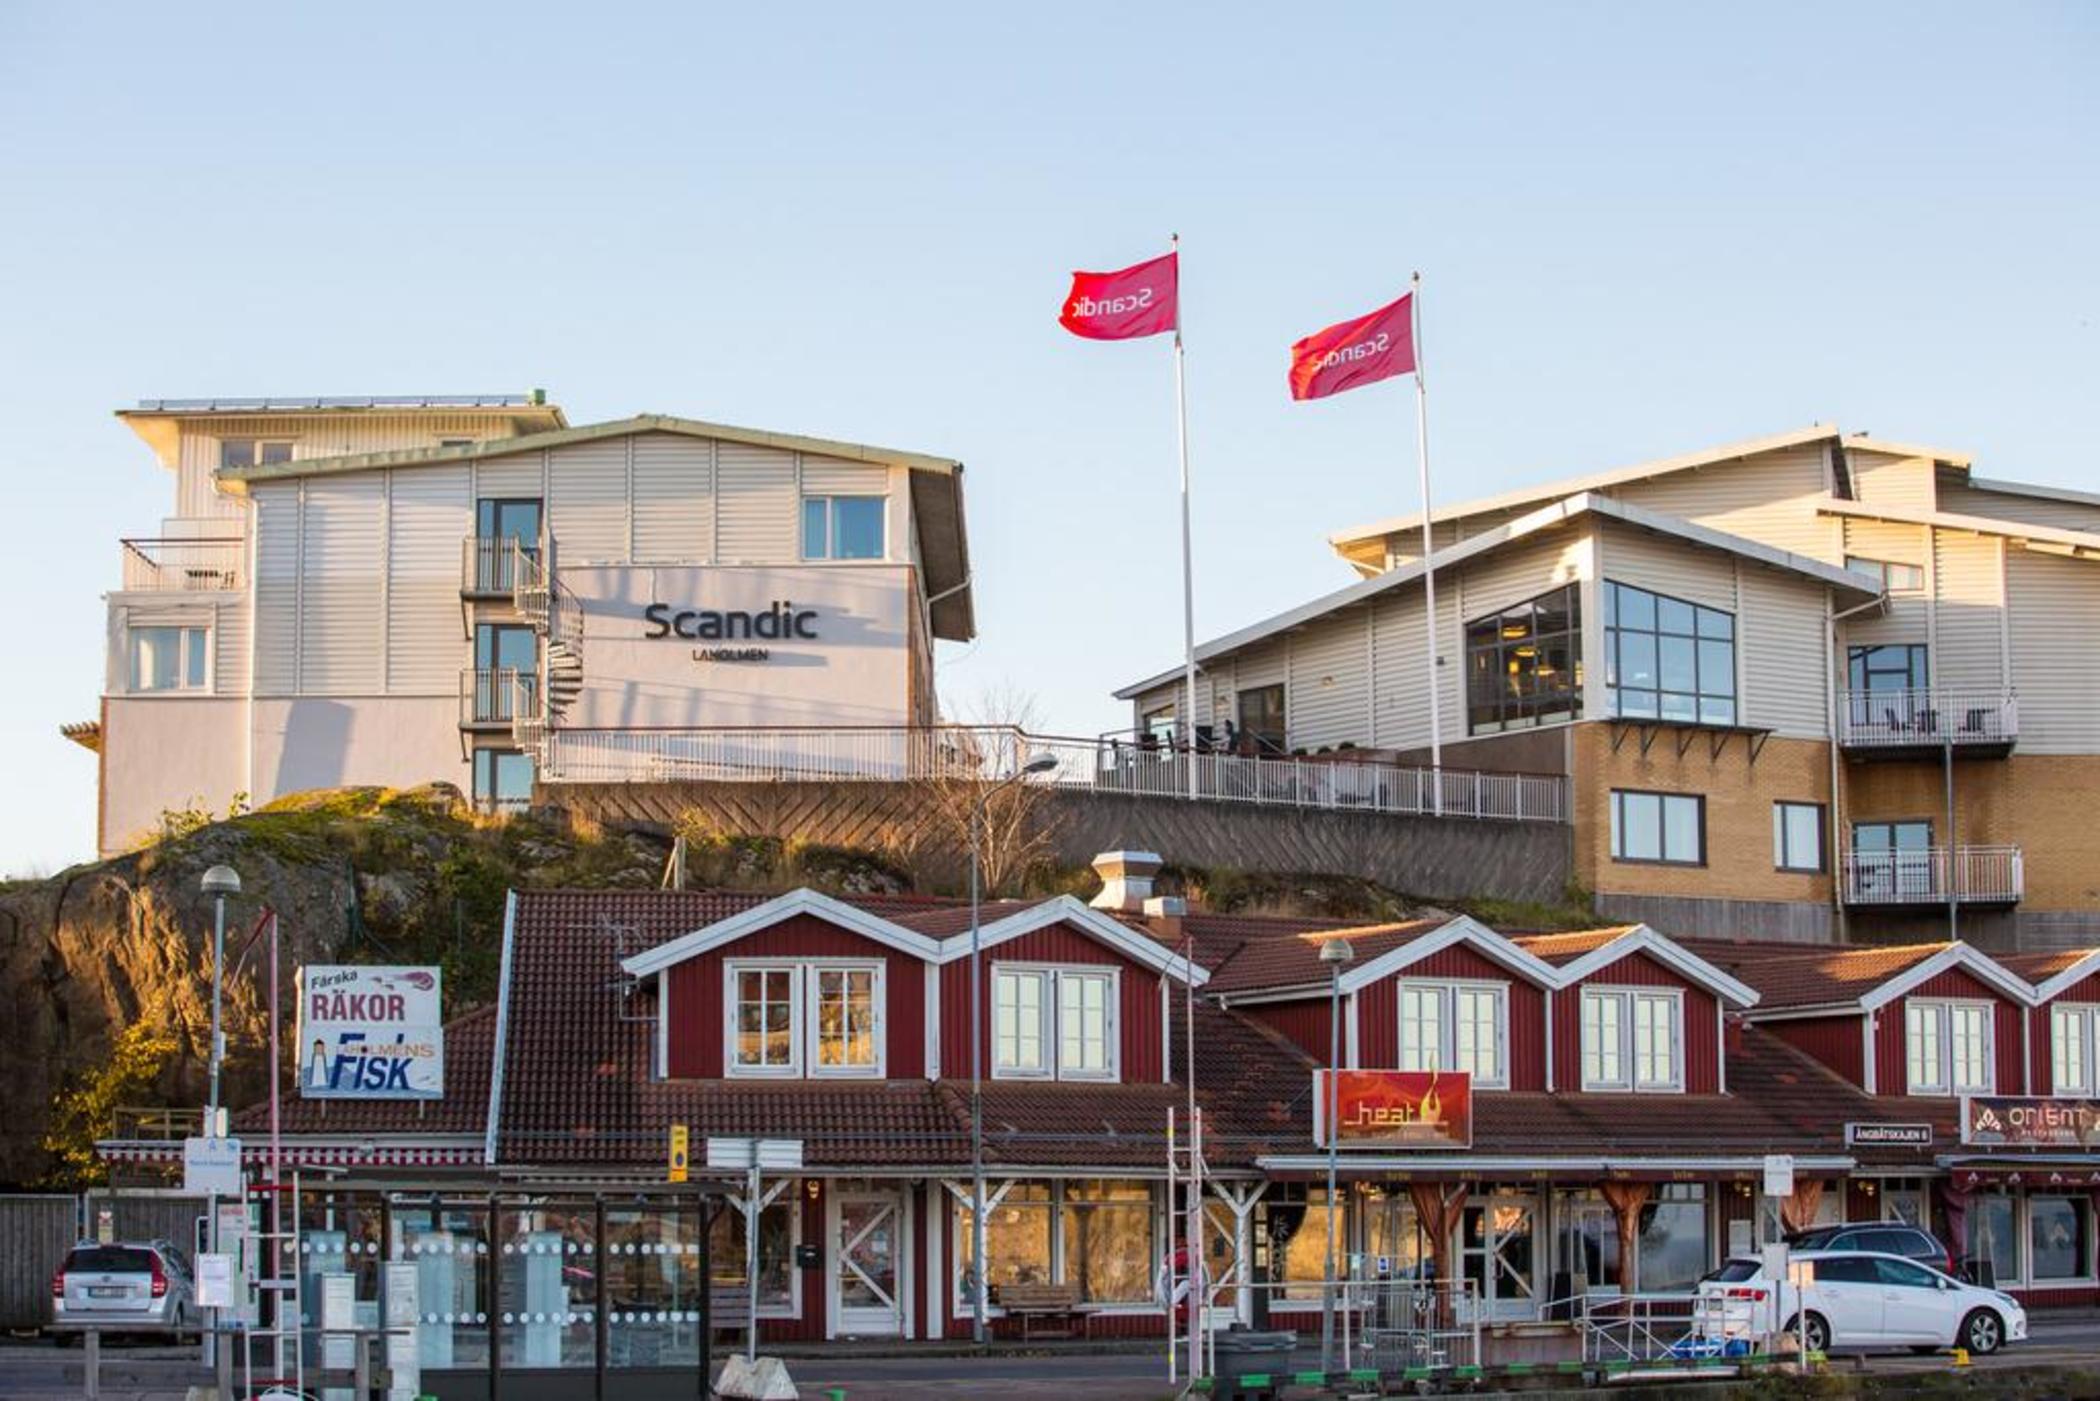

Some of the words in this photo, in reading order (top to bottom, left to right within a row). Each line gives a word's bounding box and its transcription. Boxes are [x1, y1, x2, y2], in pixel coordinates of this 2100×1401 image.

[645, 600, 818, 640] Scandic
[692, 649, 769, 662] LAHOLMEN
[311, 989, 405, 1022] RÄKOR
[1358, 1100, 1416, 1125] heat
